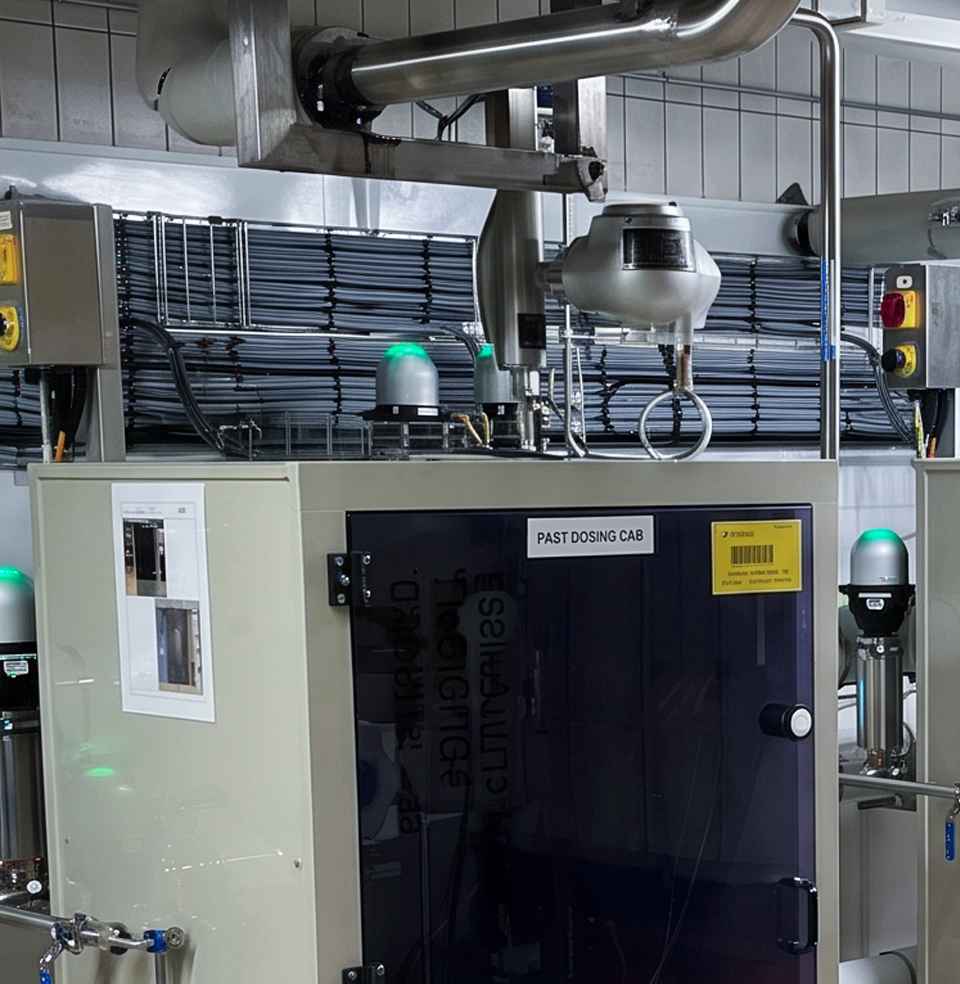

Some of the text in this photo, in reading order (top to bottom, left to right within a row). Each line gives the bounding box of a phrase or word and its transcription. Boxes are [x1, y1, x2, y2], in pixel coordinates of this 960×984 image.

[537, 529, 644, 545] PAST DOSING CAB
